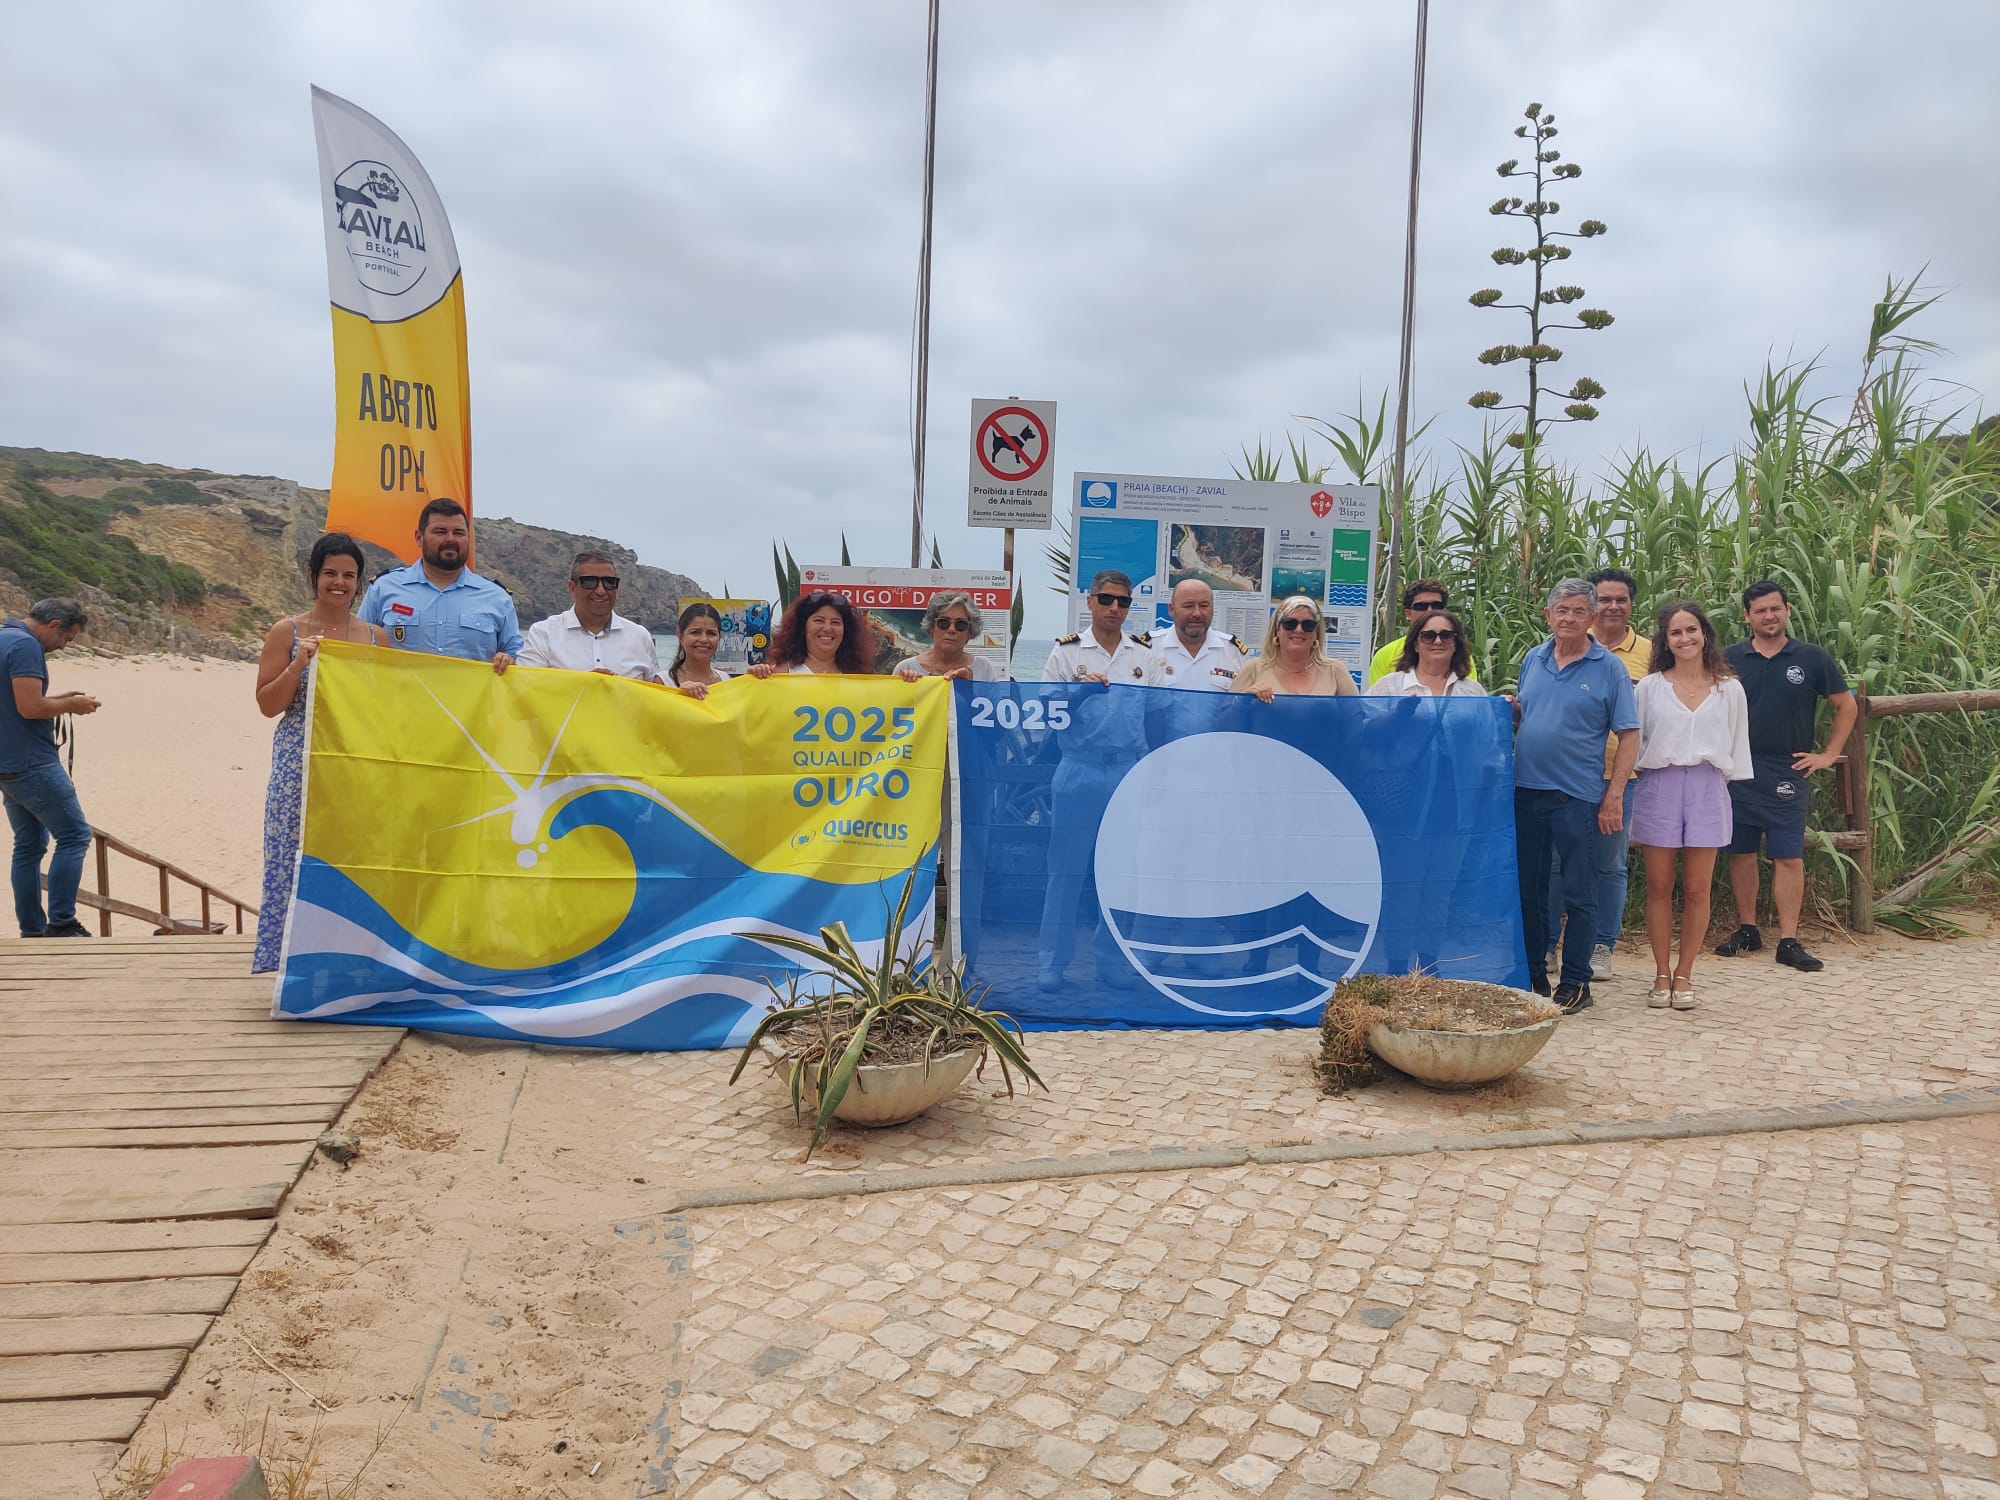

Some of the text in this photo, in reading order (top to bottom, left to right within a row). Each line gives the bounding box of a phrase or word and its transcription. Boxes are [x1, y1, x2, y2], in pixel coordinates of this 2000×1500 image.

[366, 242, 400, 259] BEACH
[359, 373, 437, 431] ABRTO
[973, 487, 1007, 496] Proibida
[1016, 488, 1048, 497] Entrada
[1124, 482, 1150, 492] PRAIA
[1152, 484, 1189, 495] (BEACH)
[1196, 486, 1227, 496] ZAVIAL
[988, 497, 1033, 506] de Animais
[1339, 496, 1357, 507] Vila
[1338, 506, 1366, 519] Bispo
[813, 588, 892, 604] RIGO
[912, 591, 998, 607] DER
[970, 696, 1072, 730] 2025
[793, 705, 915, 743] 2025
[793, 744, 914, 767] QUALIDADE
[793, 768, 910, 808] OURO
[822, 819, 909, 841] Quercus
